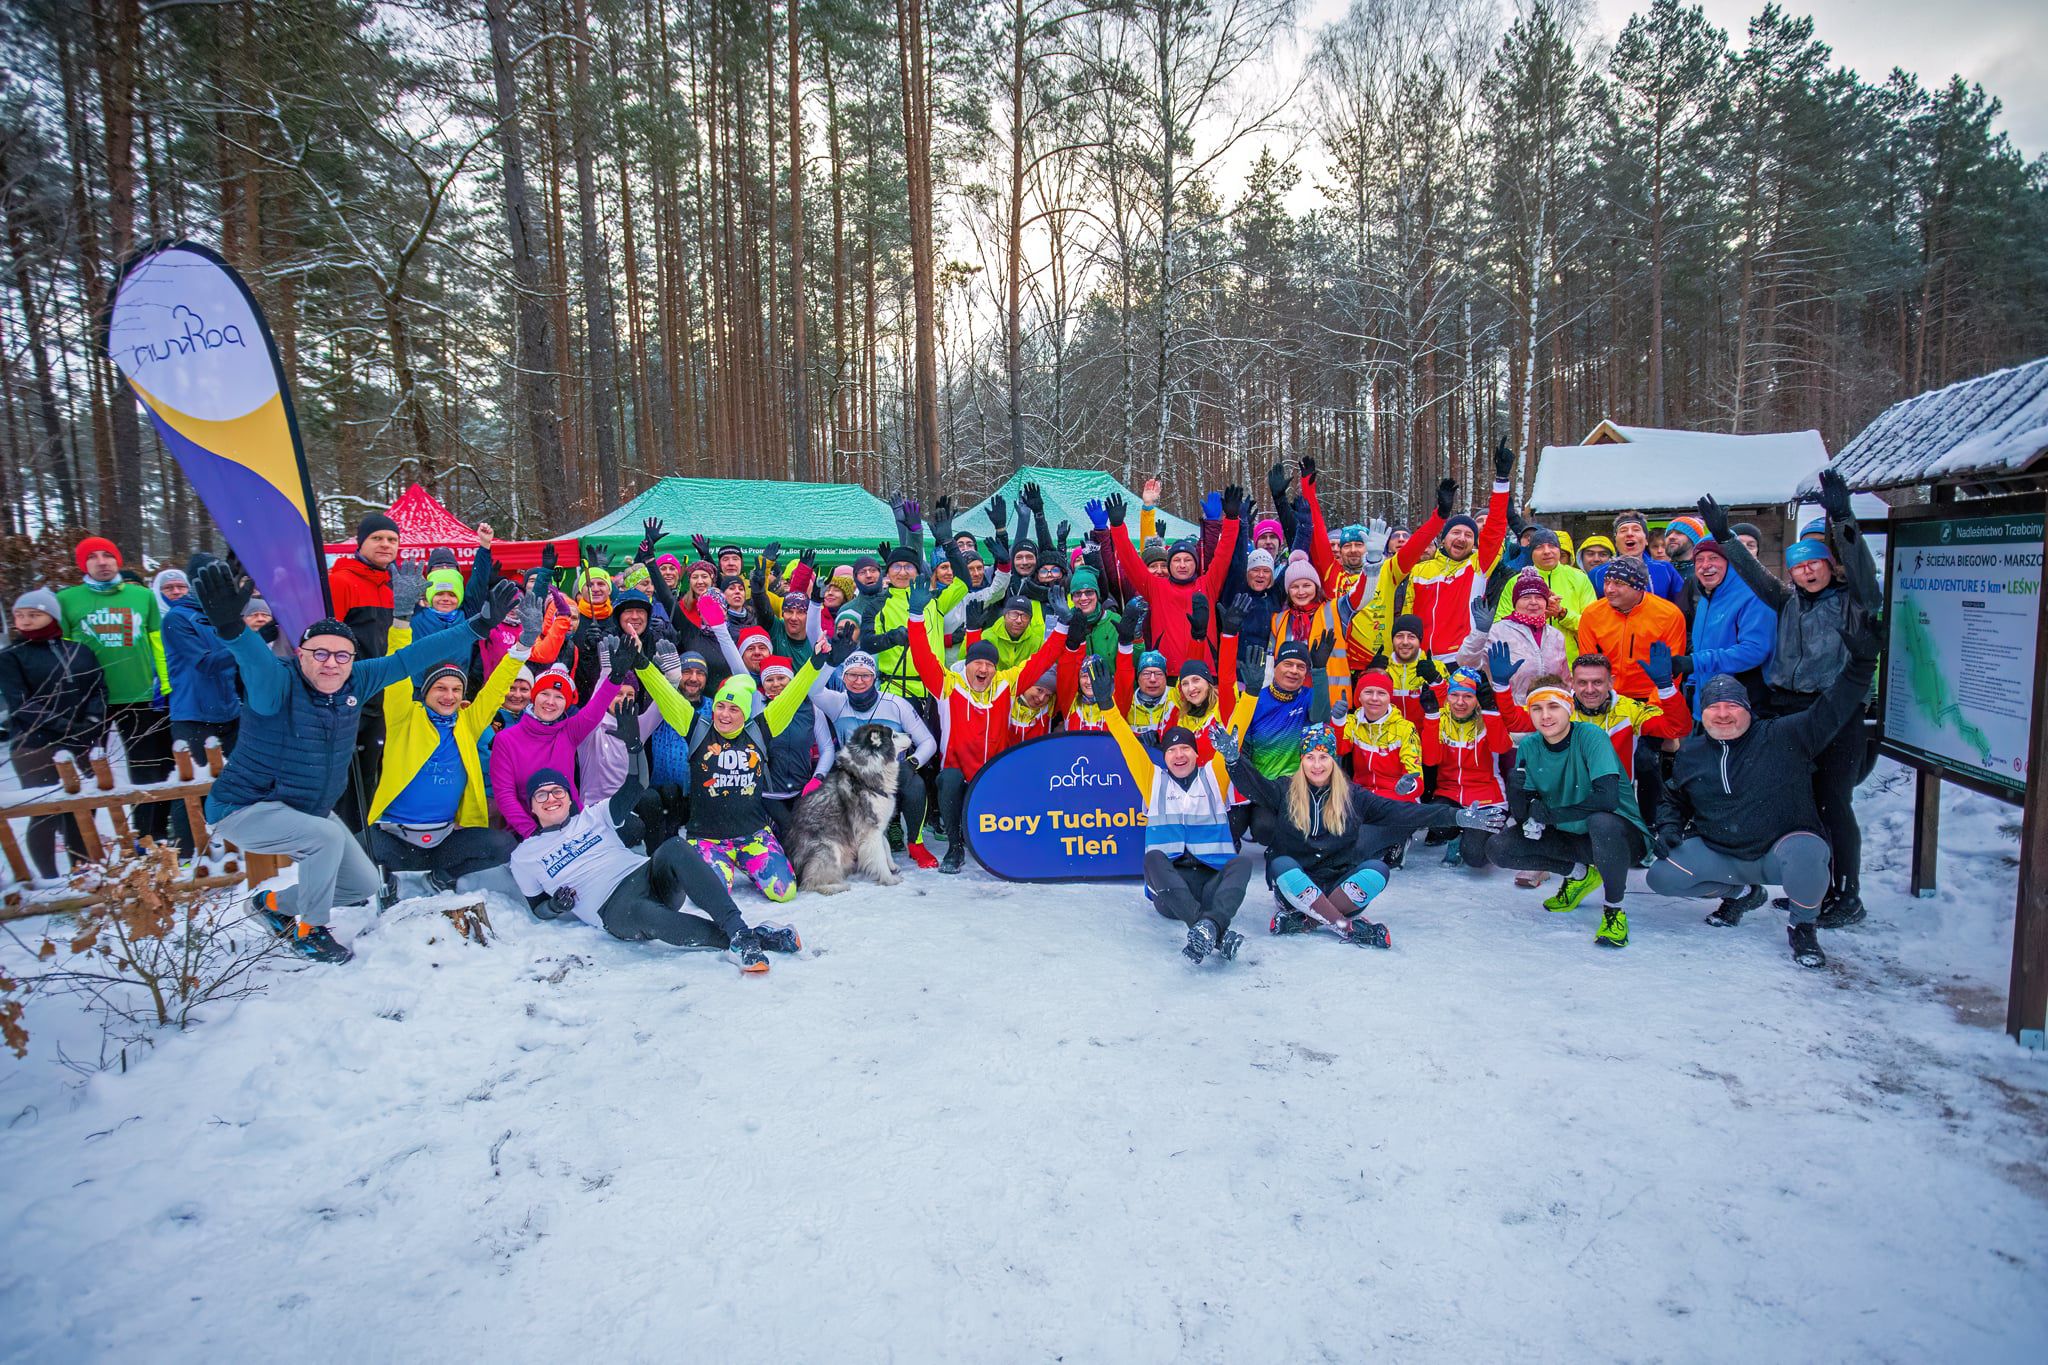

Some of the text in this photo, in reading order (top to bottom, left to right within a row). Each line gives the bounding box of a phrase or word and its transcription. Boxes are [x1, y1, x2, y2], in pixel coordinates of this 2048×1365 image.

[1956, 522, 2044, 538] Nadleśnictwo Trzebciny
[400, 548, 425, 559] 601
[1926, 553, 1956, 567] ŚCIEŻKA
[1957, 554, 1997, 567] BIEGOWO
[1900, 577, 2040, 595] KLAUDI ADVENTURE 5 km LEŚNY
[87, 613, 122, 625] RUN
[100, 633, 122, 641] RUN
[1049, 756, 1122, 791] parkrun
[979, 813, 1041, 836] Bory
[1060, 834, 1118, 856] Tleń
